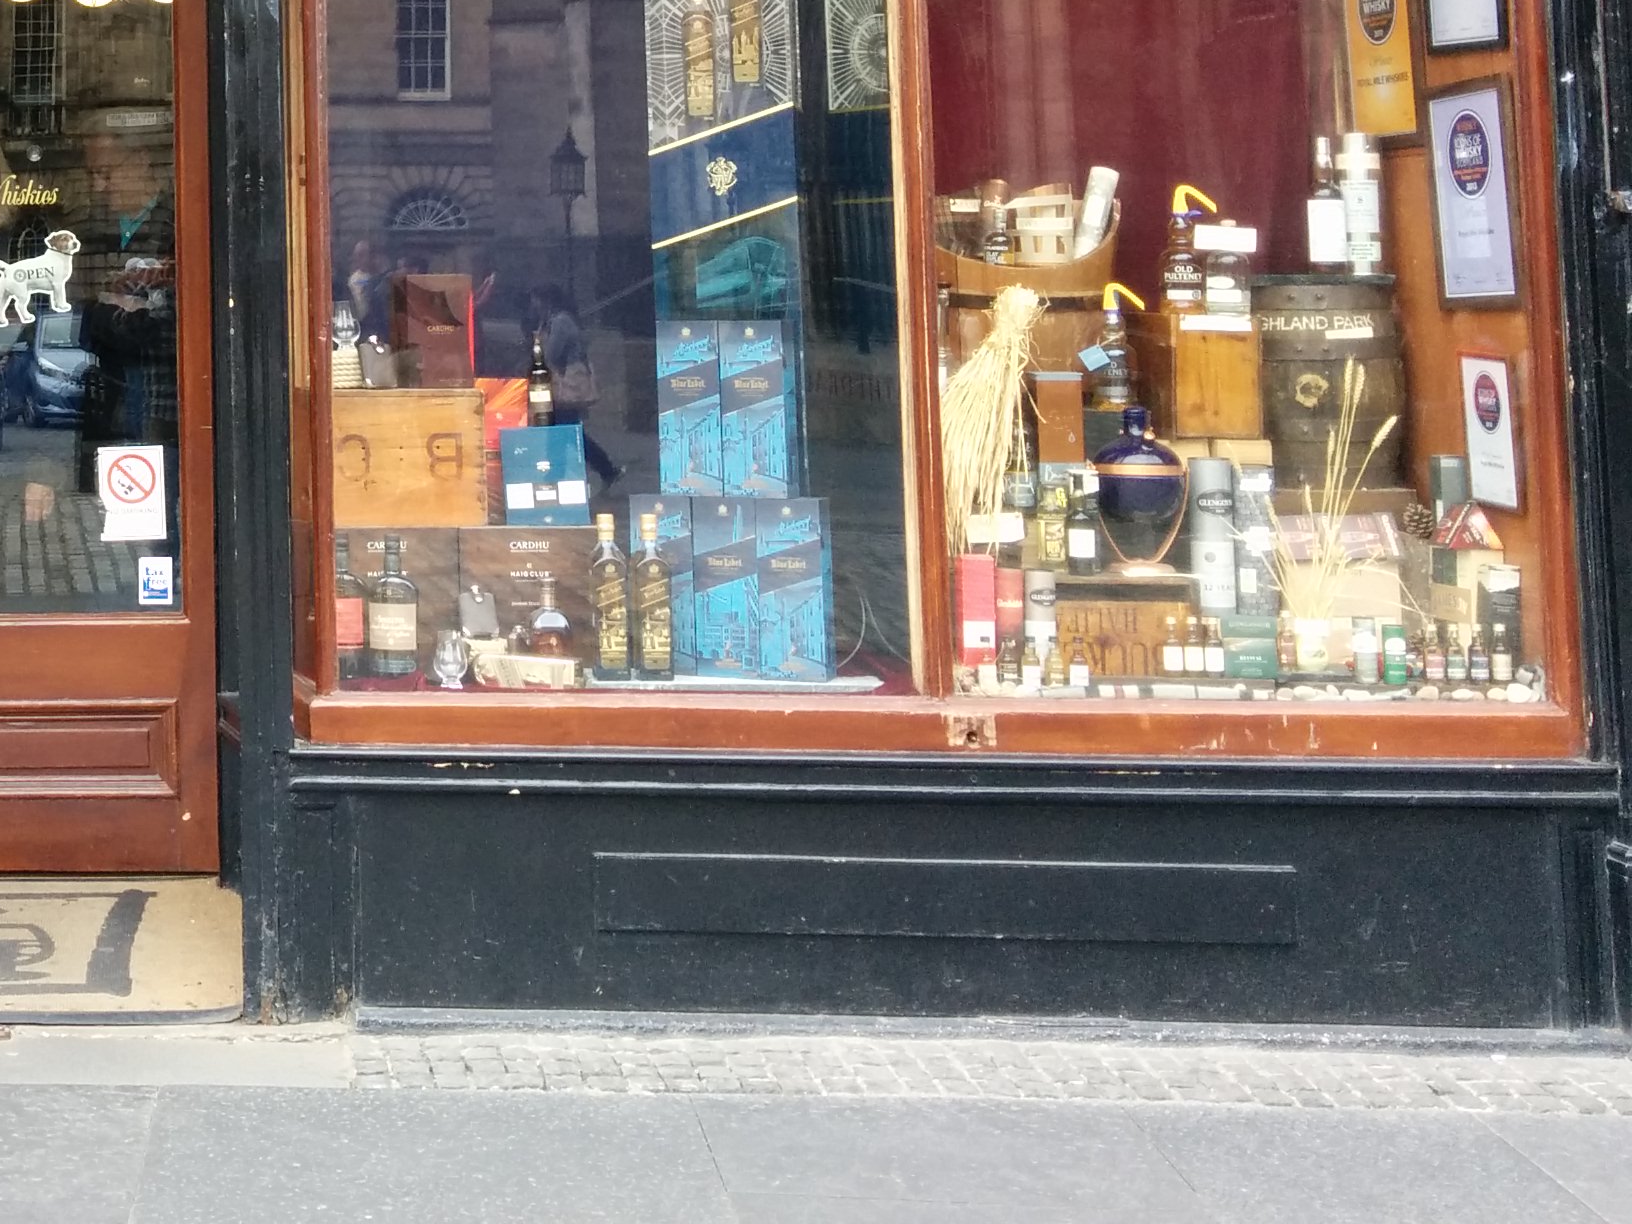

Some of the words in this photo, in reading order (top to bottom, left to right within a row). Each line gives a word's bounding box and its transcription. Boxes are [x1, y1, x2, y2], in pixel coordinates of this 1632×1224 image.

[1175, 265, 1193, 273] OLD
[13, 266, 54, 283] OPEN
[1261, 316, 1328, 331] GHLAND
[1333, 314, 1375, 330] PARK
[367, 541, 407, 549] CARU
[510, 541, 550, 550] CARDHU
